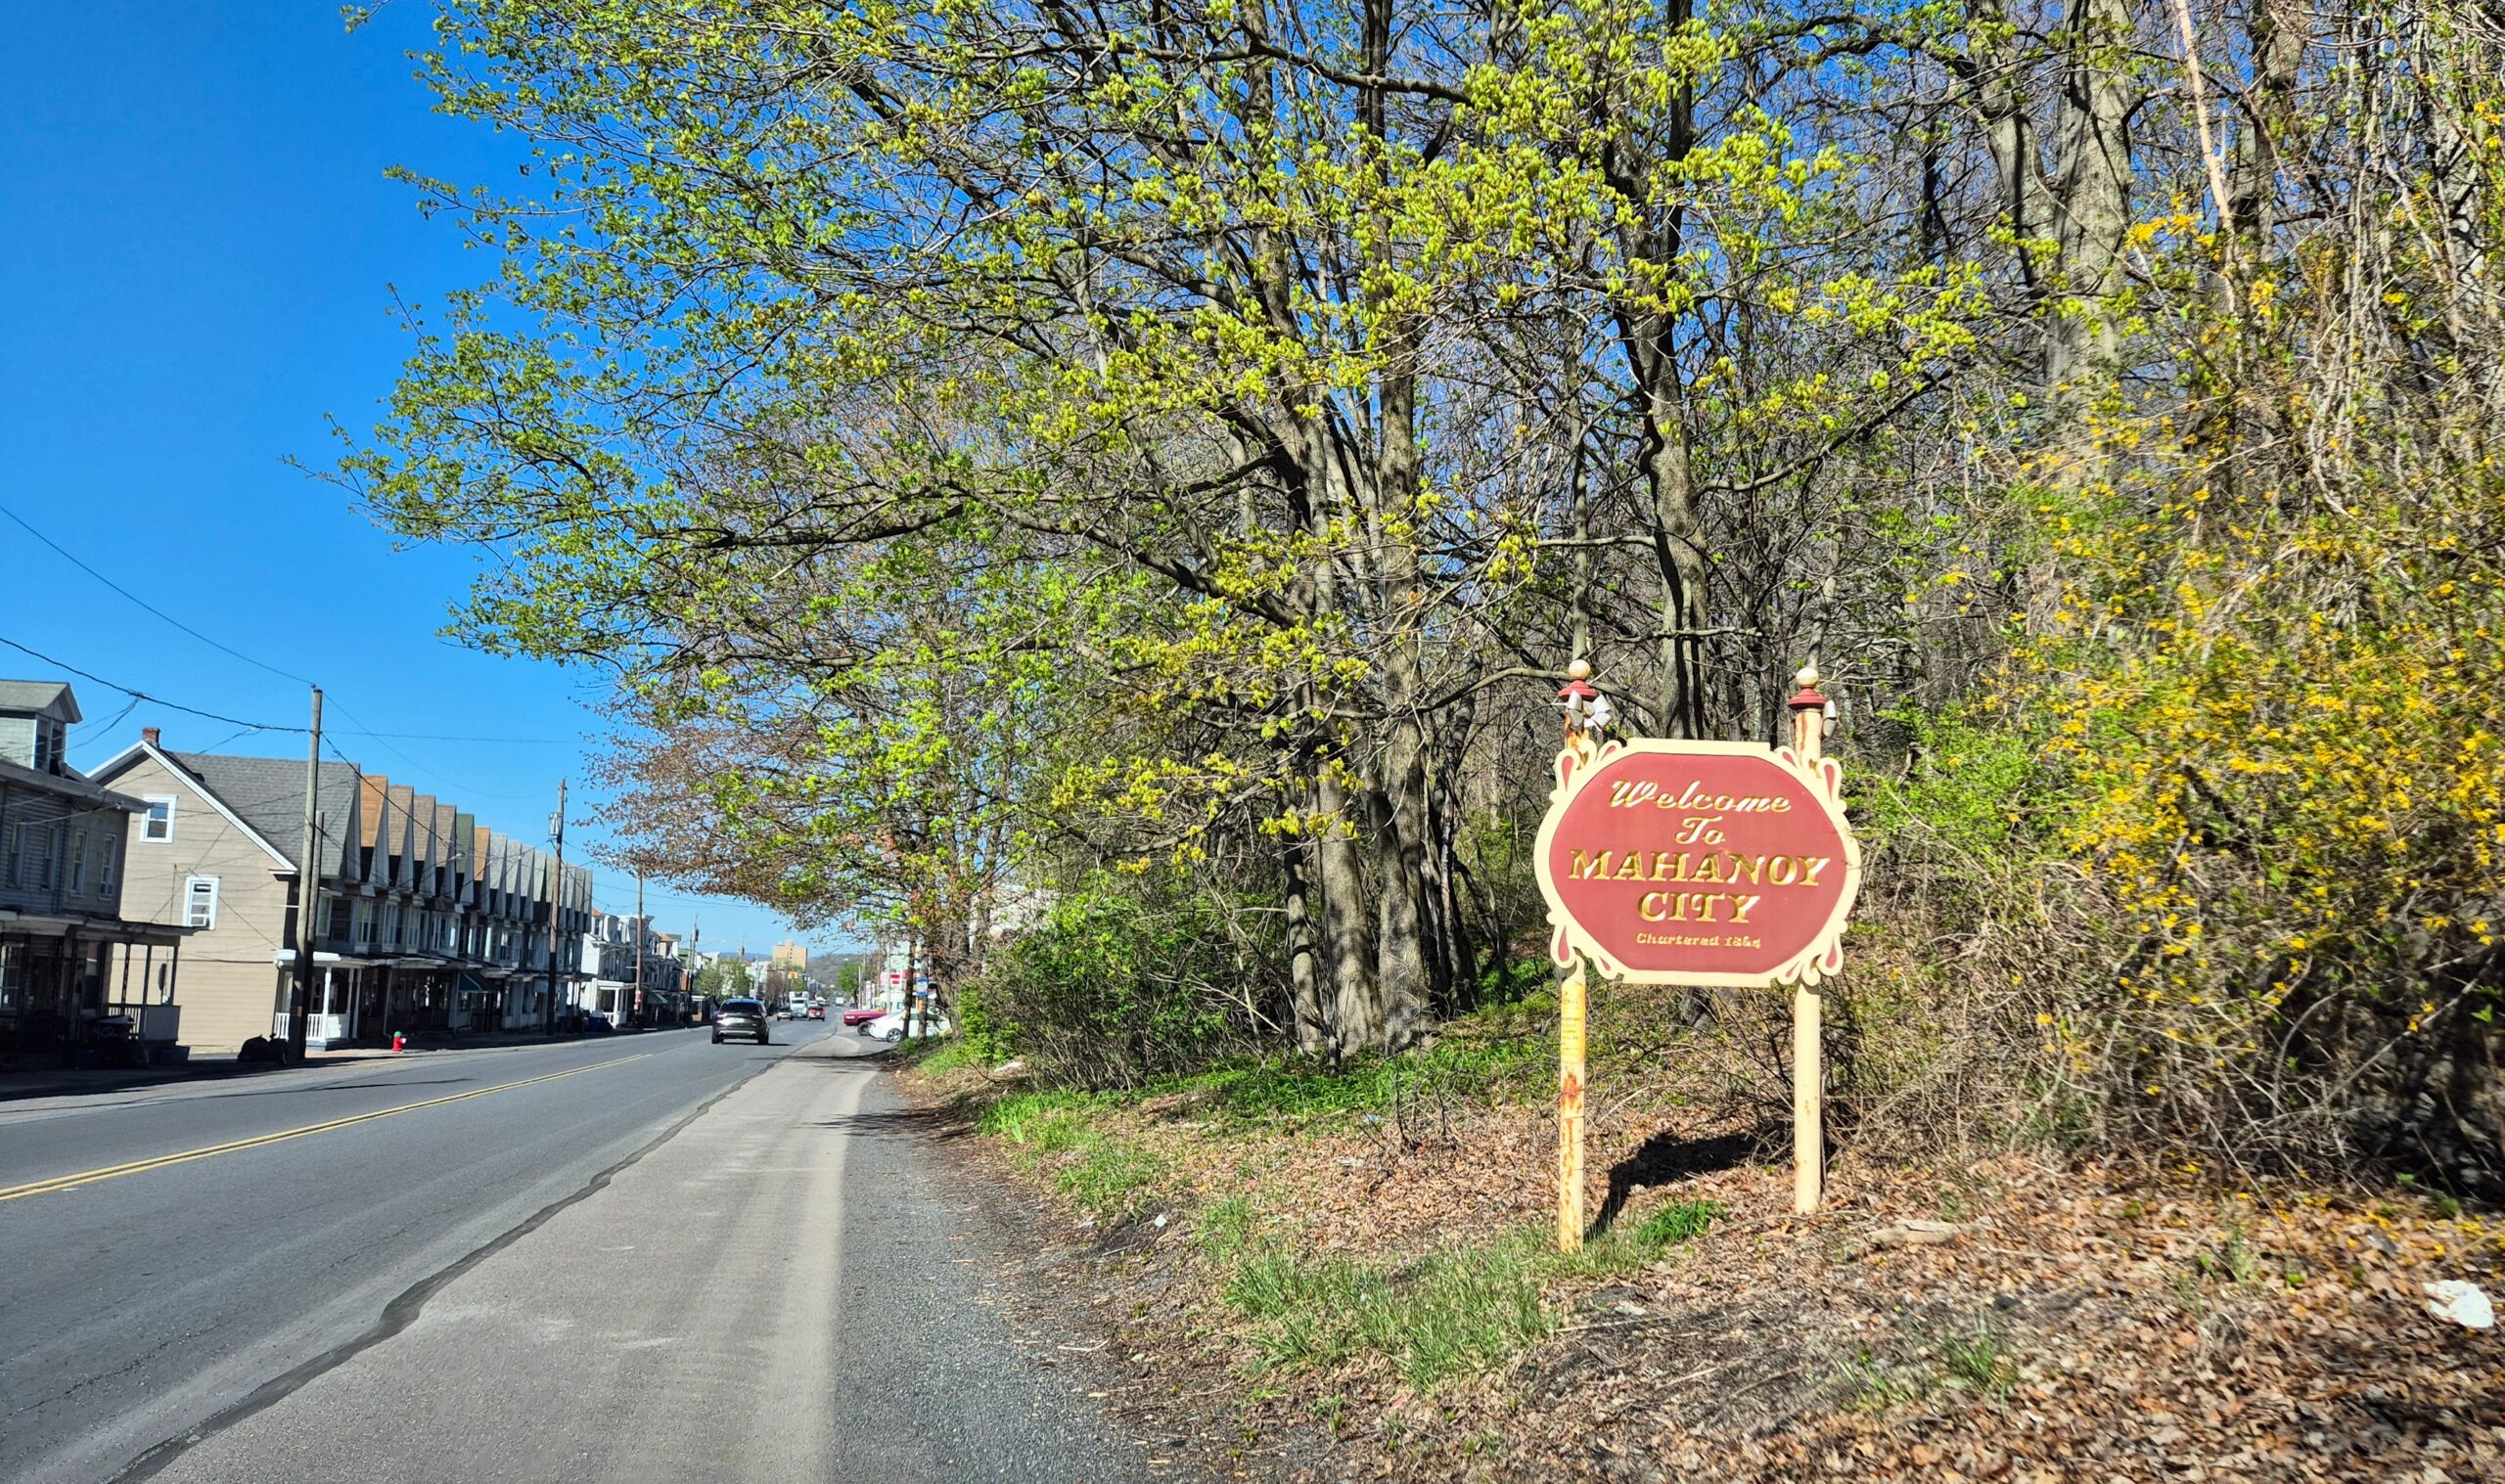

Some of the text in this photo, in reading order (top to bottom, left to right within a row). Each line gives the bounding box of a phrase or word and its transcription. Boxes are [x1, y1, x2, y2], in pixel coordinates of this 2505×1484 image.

[1609, 780, 1792, 813] Welcome
[1674, 815, 1726, 845] To
[1568, 849, 1830, 886] MAHANOY
[1637, 891, 1760, 923] CITY
[1636, 932, 1719, 947] Chartered
